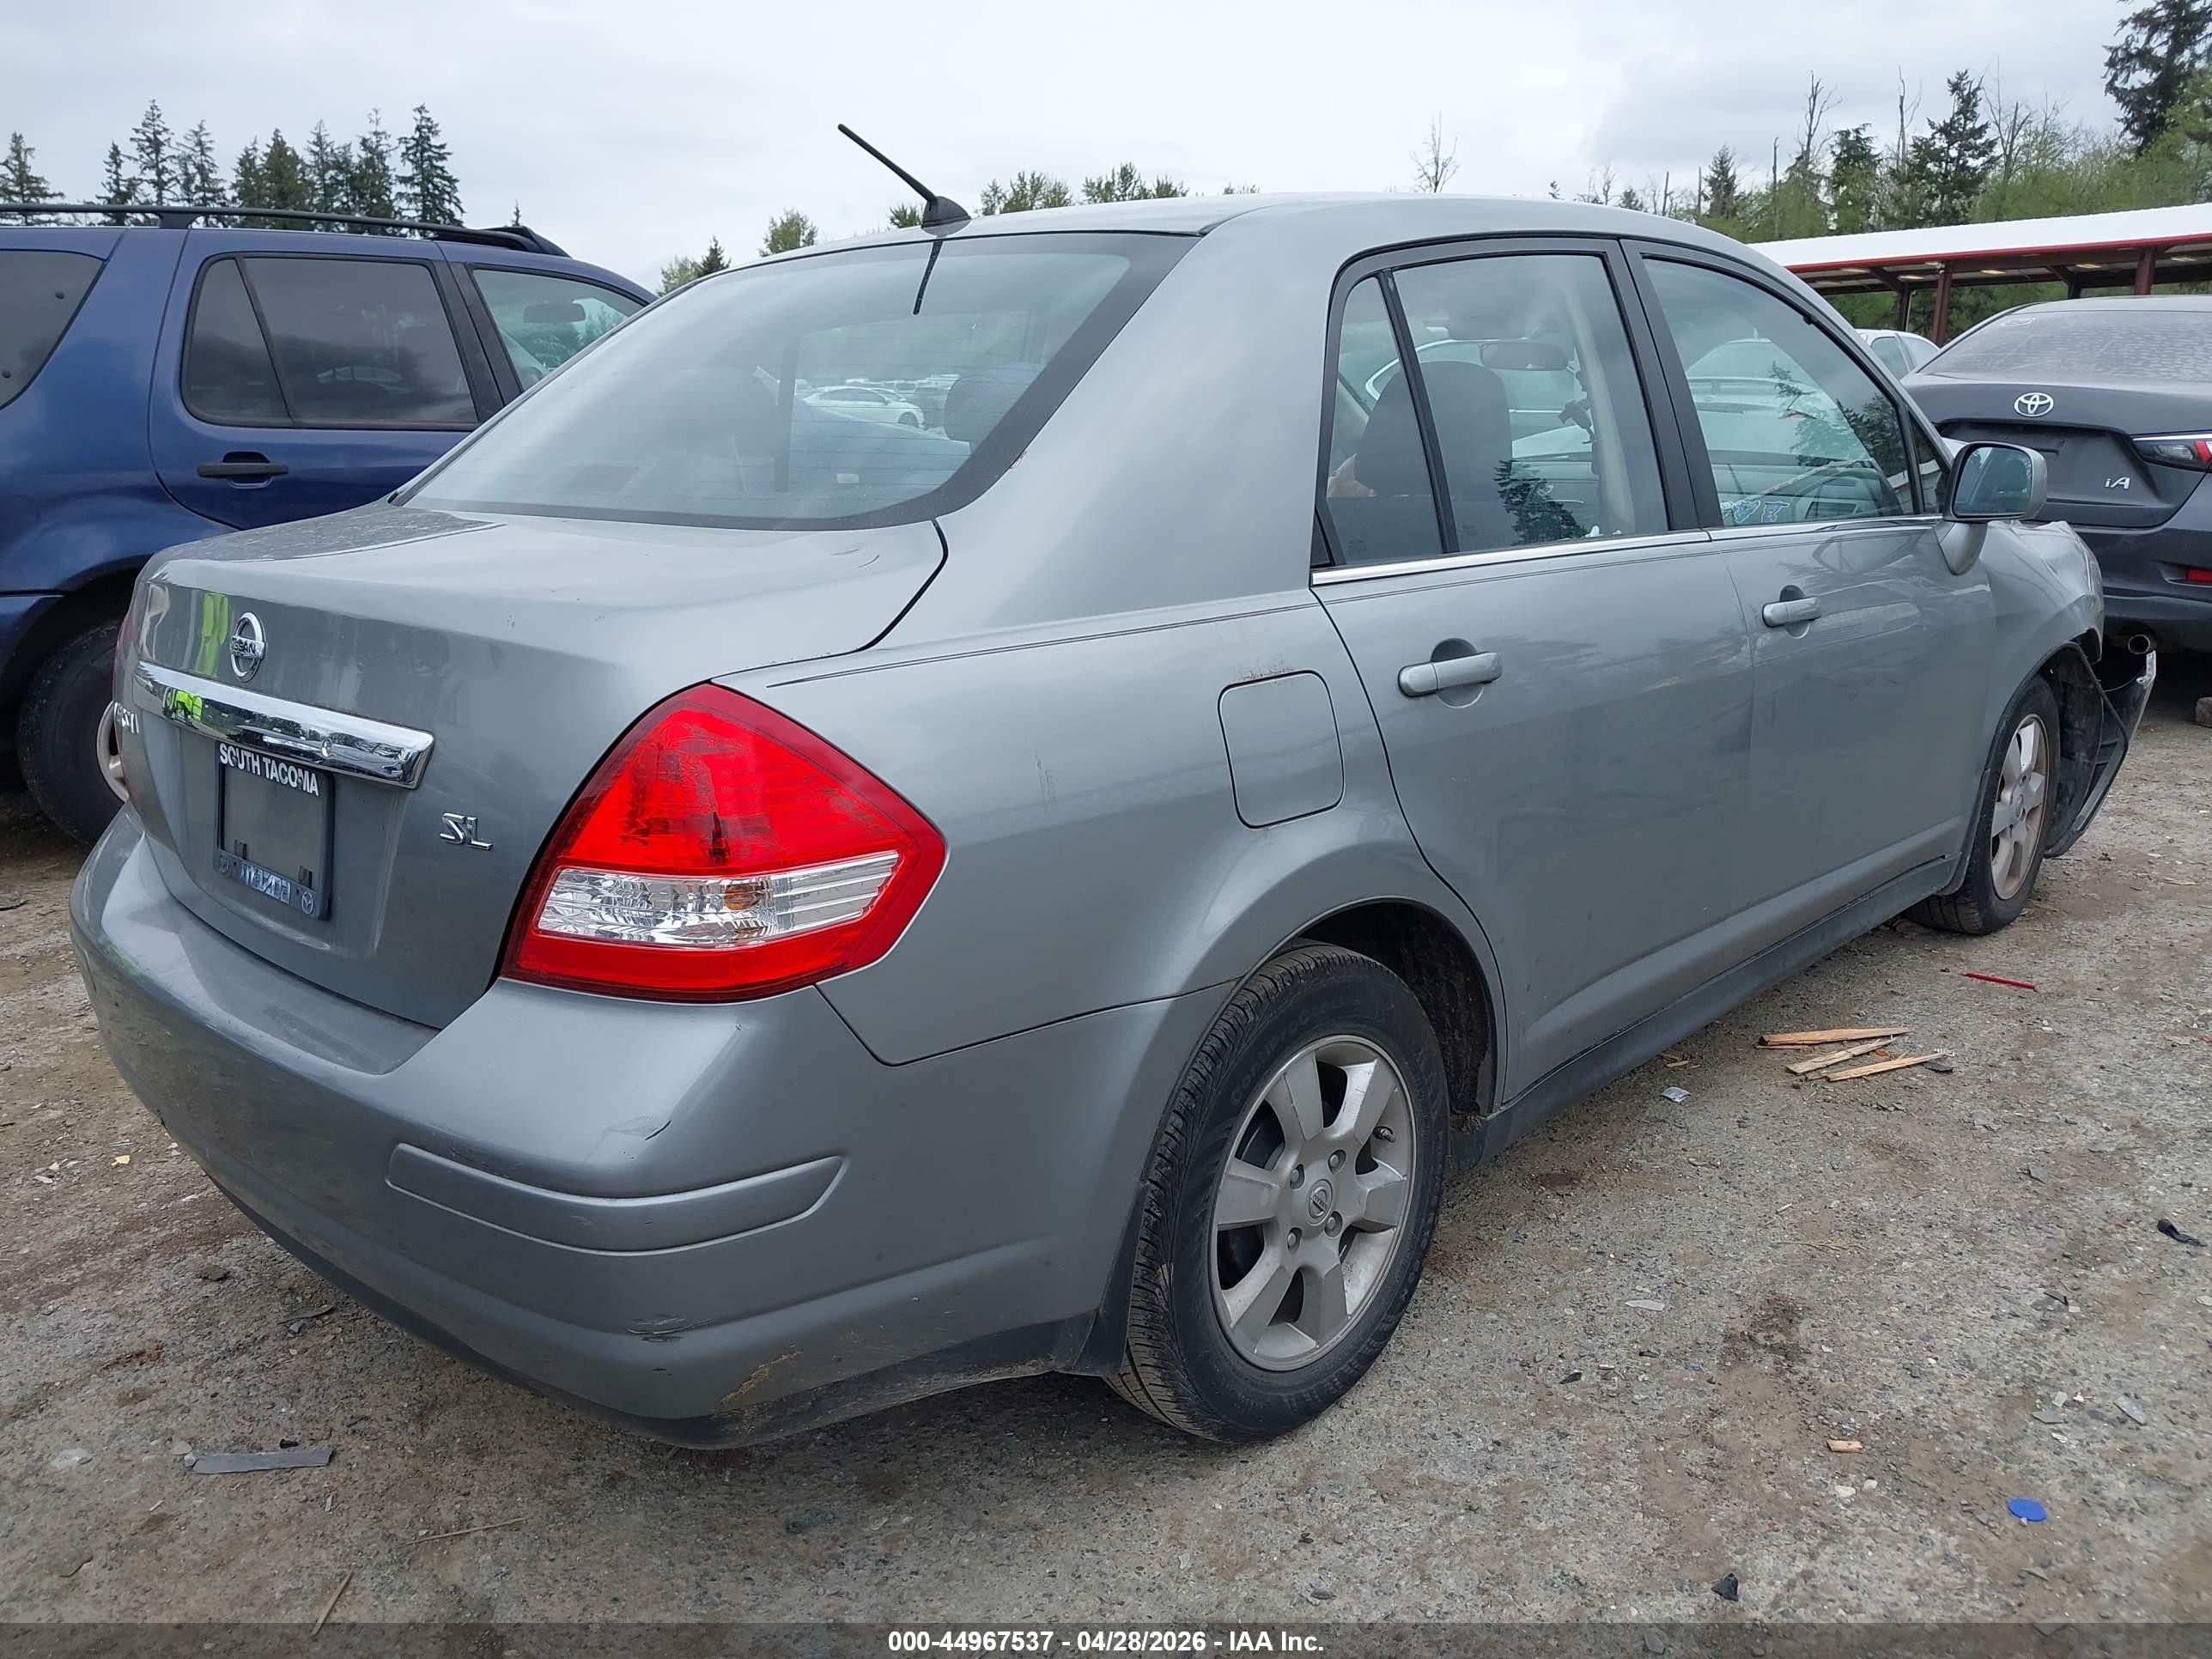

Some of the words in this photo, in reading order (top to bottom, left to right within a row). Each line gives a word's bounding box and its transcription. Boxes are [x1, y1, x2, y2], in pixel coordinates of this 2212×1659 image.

[2105, 477, 2130, 489] iA
[219, 743, 261, 776] SOUTH
[262, 757, 319, 797] TACOMA
[440, 812, 494, 851] SL
